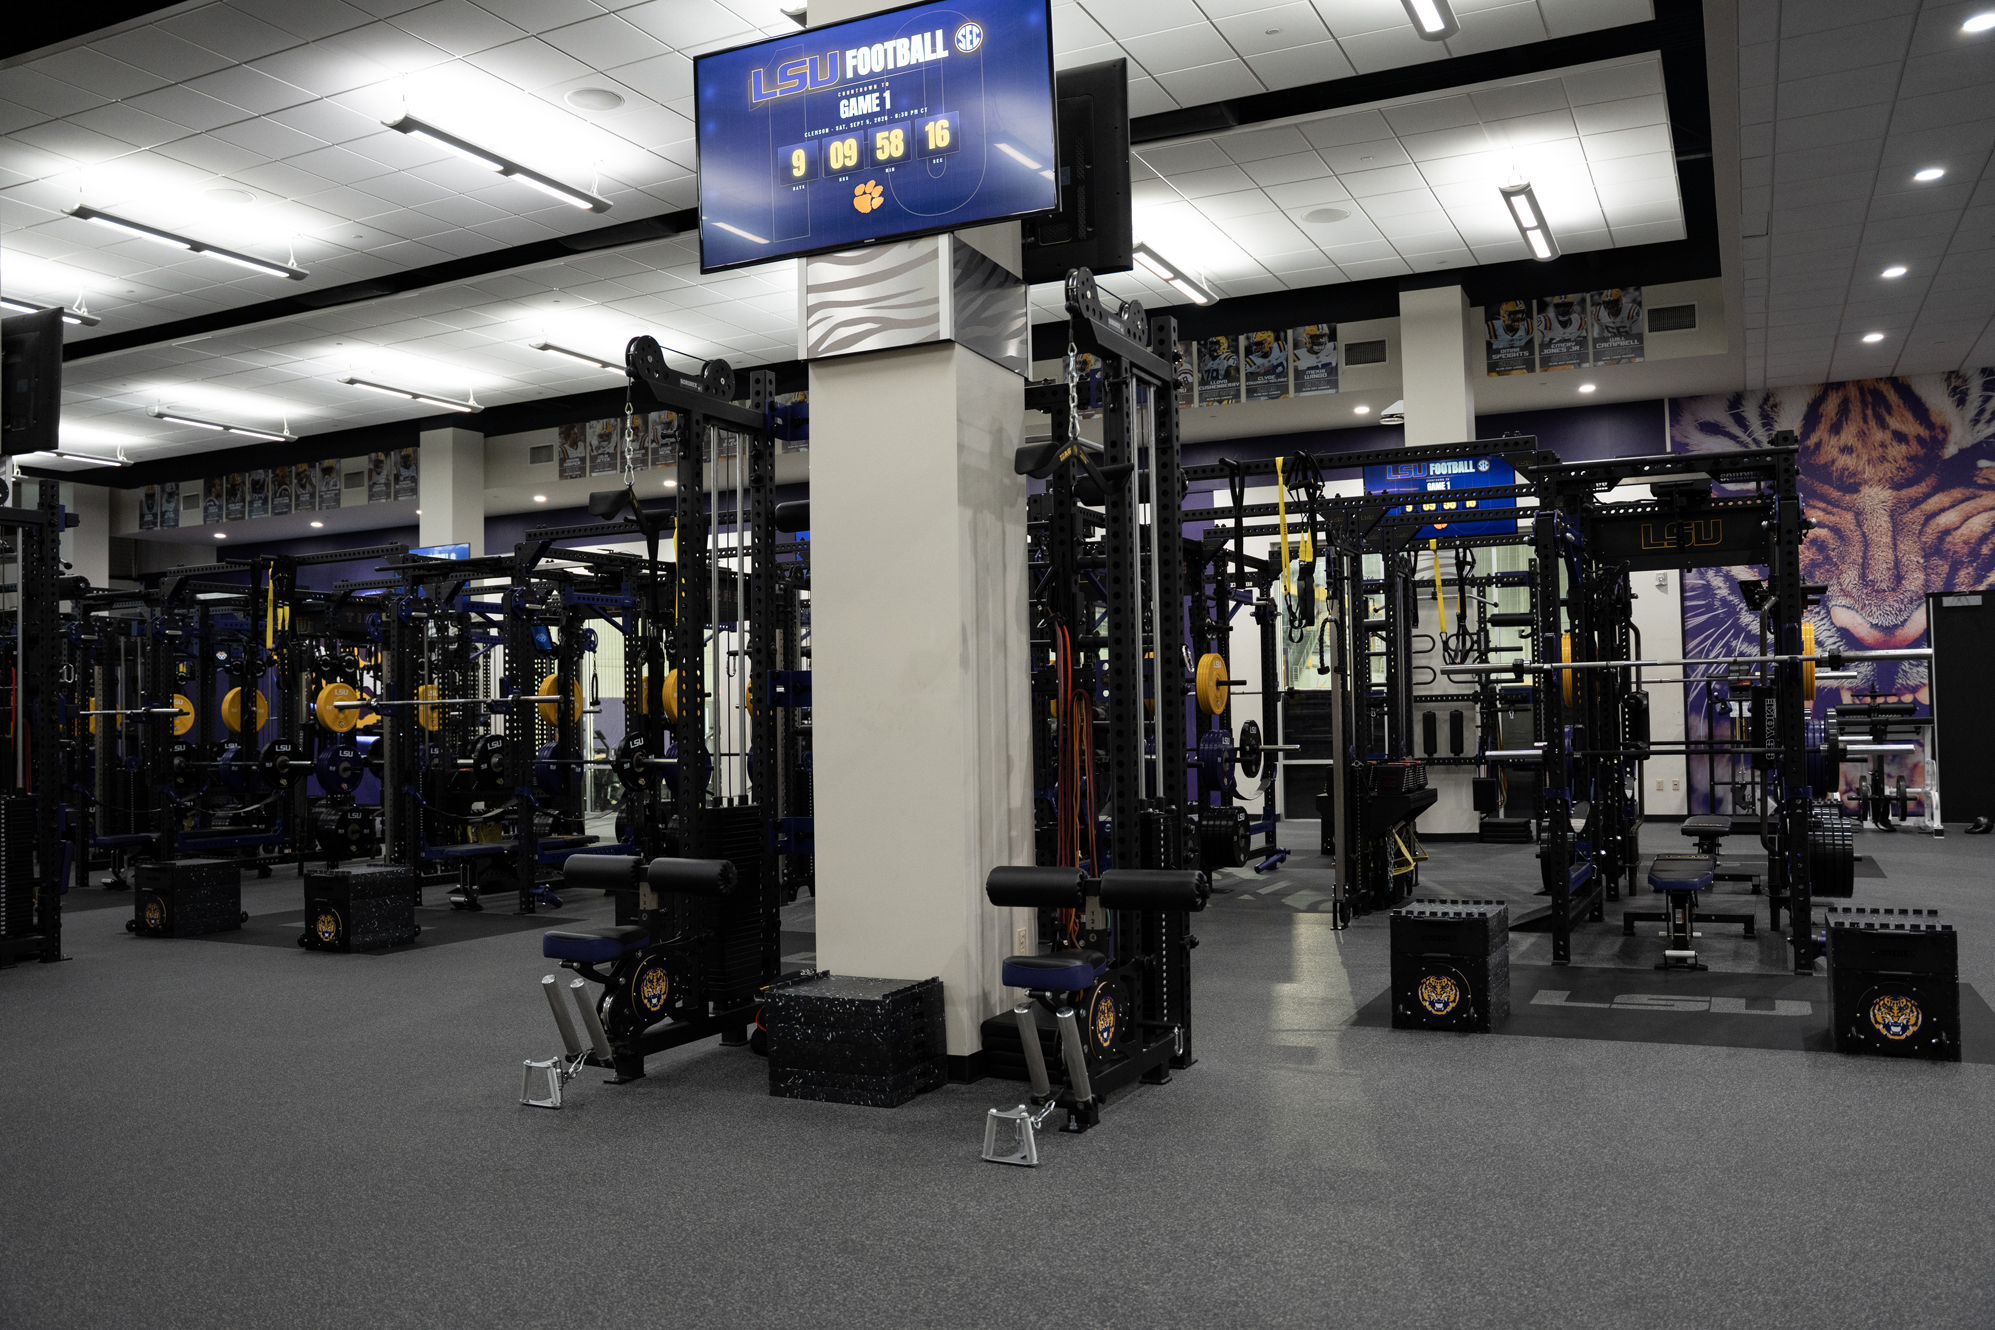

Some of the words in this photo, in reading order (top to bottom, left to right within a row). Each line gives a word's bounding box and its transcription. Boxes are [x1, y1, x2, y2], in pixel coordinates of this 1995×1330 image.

[752, 51, 840, 103] LSU
[846, 29, 949, 79] FOOTBALL
[957, 25, 981, 51] SEC
[838, 84, 877, 97] COUNTDOWN
[840, 92, 880, 119] GAME
[883, 90, 891, 110] 1
[804, 128, 829, 138] CLEMSON
[850, 120, 864, 128] SEPT
[791, 149, 806, 177] 9
[829, 138, 858, 169] 09
[875, 128, 904, 160] 58
[924, 119, 950, 150] 16
[1596, 339, 1640, 348] CAMPBELL
[1492, 350, 1529, 360] SPEIGHTS
[1386, 463, 1427, 480] LSU
[1430, 460, 1475, 476] FOOTBALL
[1478, 460, 1490, 471] SEC
[1427, 482, 1446, 491] GAME
[1641, 519, 1722, 549] LSU
[1213, 660, 1222, 668] LSU
[1249, 726, 1257, 734] LSU
[487, 739, 502, 750] LSU
[629, 737, 644, 749] LSU
[1222, 736, 1230, 745] LSU
[174, 744, 186, 752] SU
[275, 744, 291, 752] LSU
[430, 747, 439, 755] LS
[339, 750, 354, 758] LSU
[1237, 812, 1245, 821] LSU
[1530, 989, 1813, 1016] LSU
